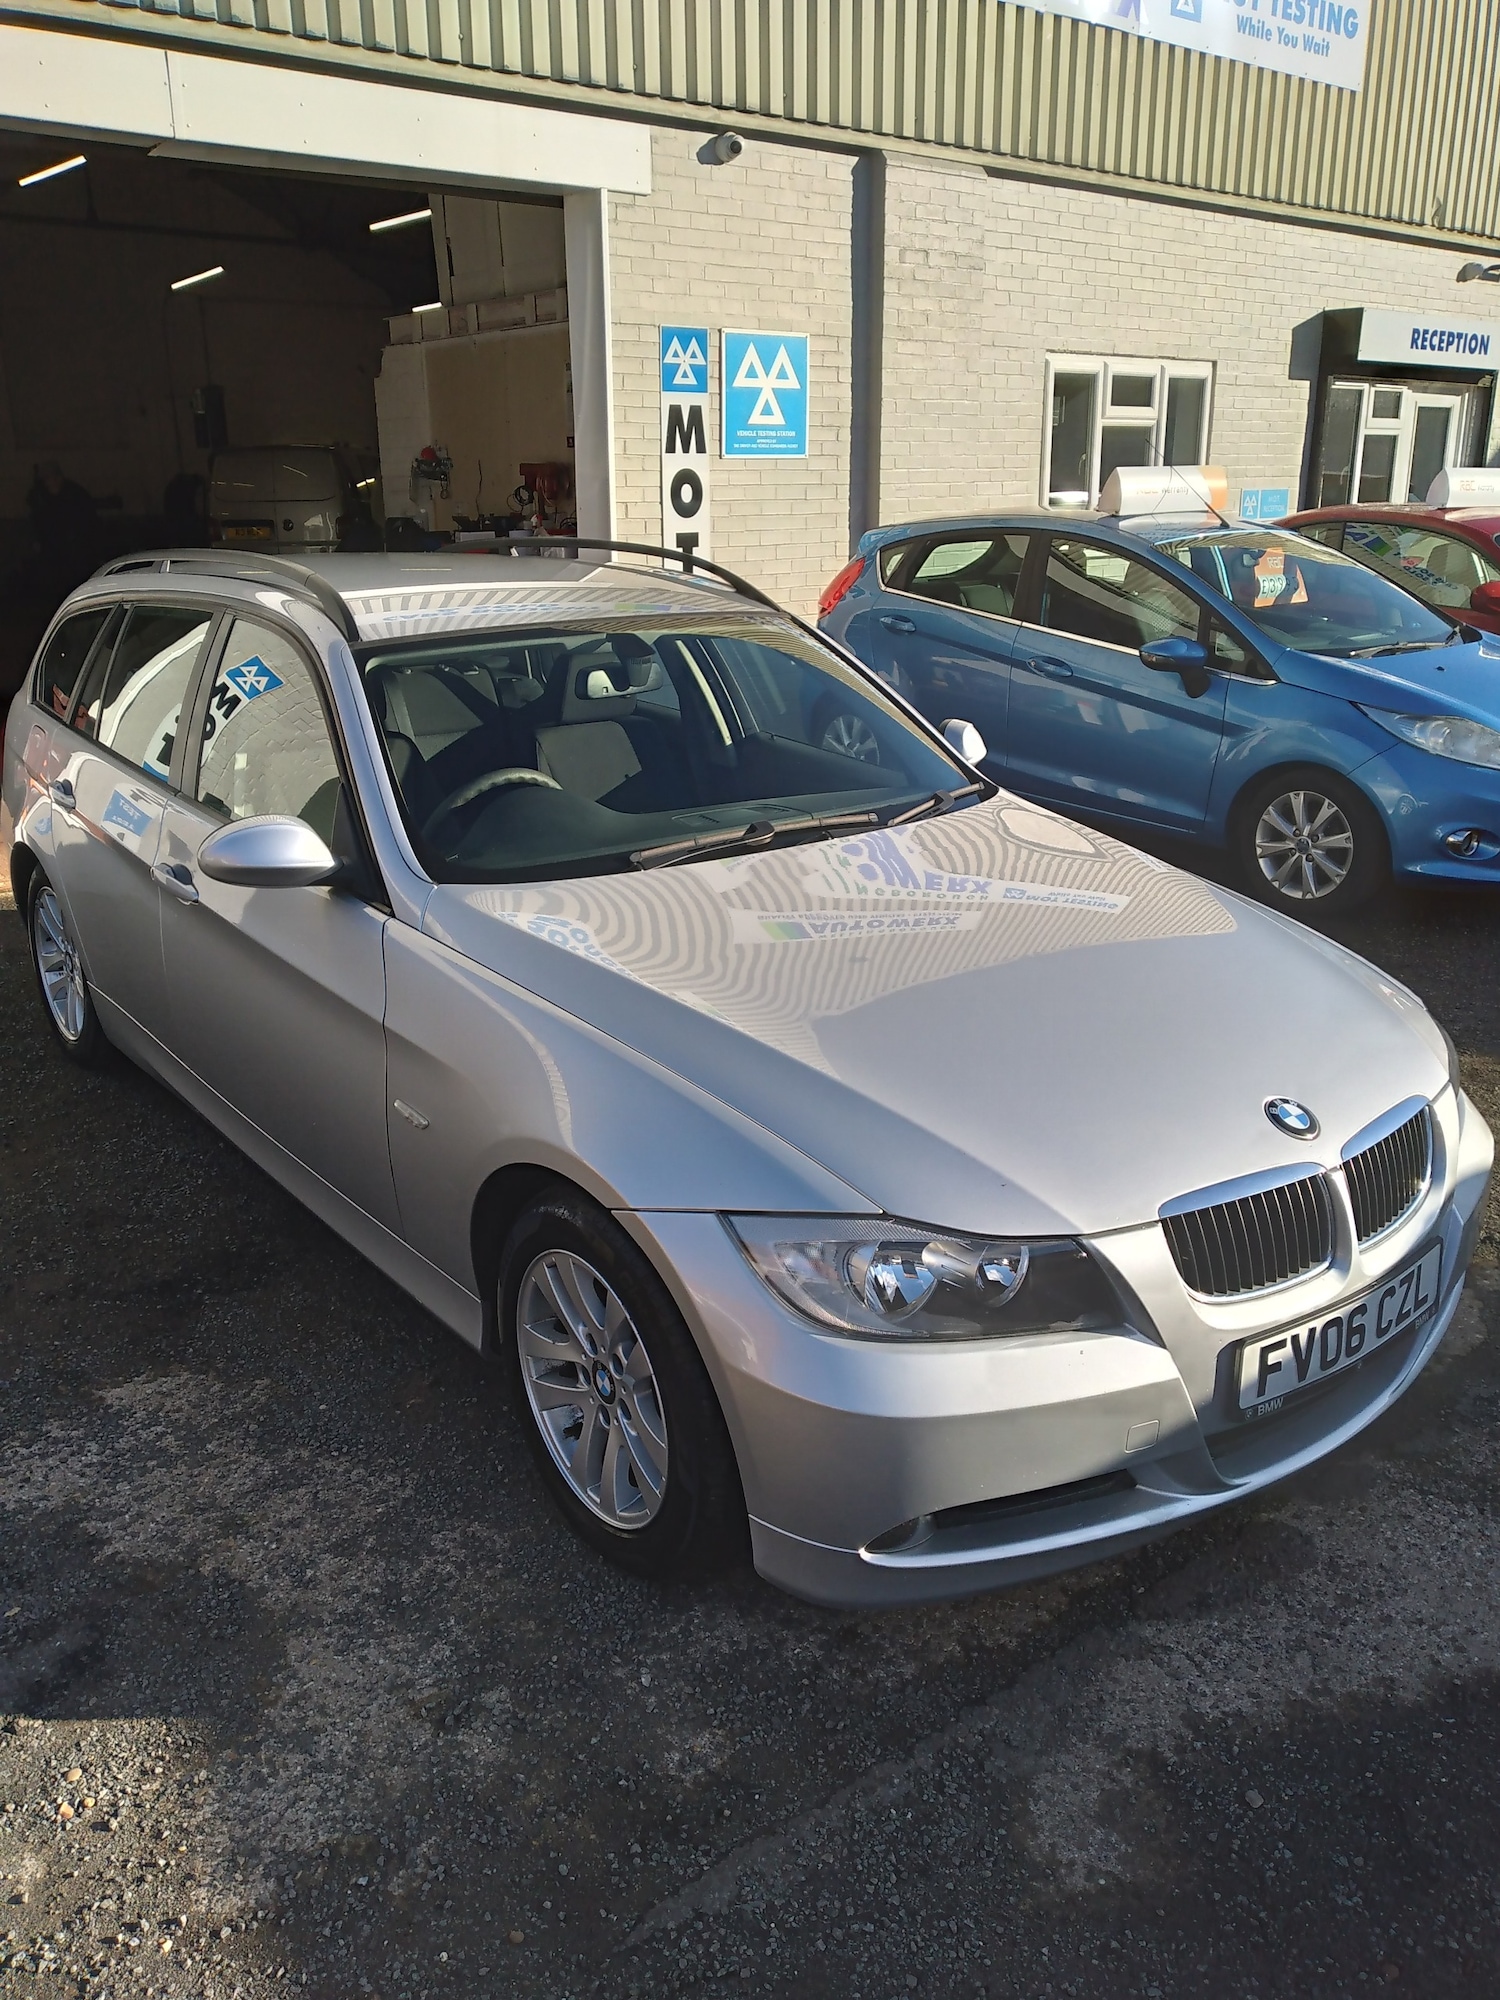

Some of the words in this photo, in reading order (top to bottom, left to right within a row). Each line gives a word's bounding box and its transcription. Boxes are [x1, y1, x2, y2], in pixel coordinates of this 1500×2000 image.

[1236, 14, 1272, 42] While
[1277, 26, 1298, 49] You
[1303, 33, 1330, 57] Wait
[1410, 327, 1490, 355] RECEPTION
[665, 404, 707, 573] MOT
[1256, 1302, 1367, 1398] FV06
[1376, 1262, 1429, 1339] CZL
[1257, 1396, 1284, 1417] BMW
